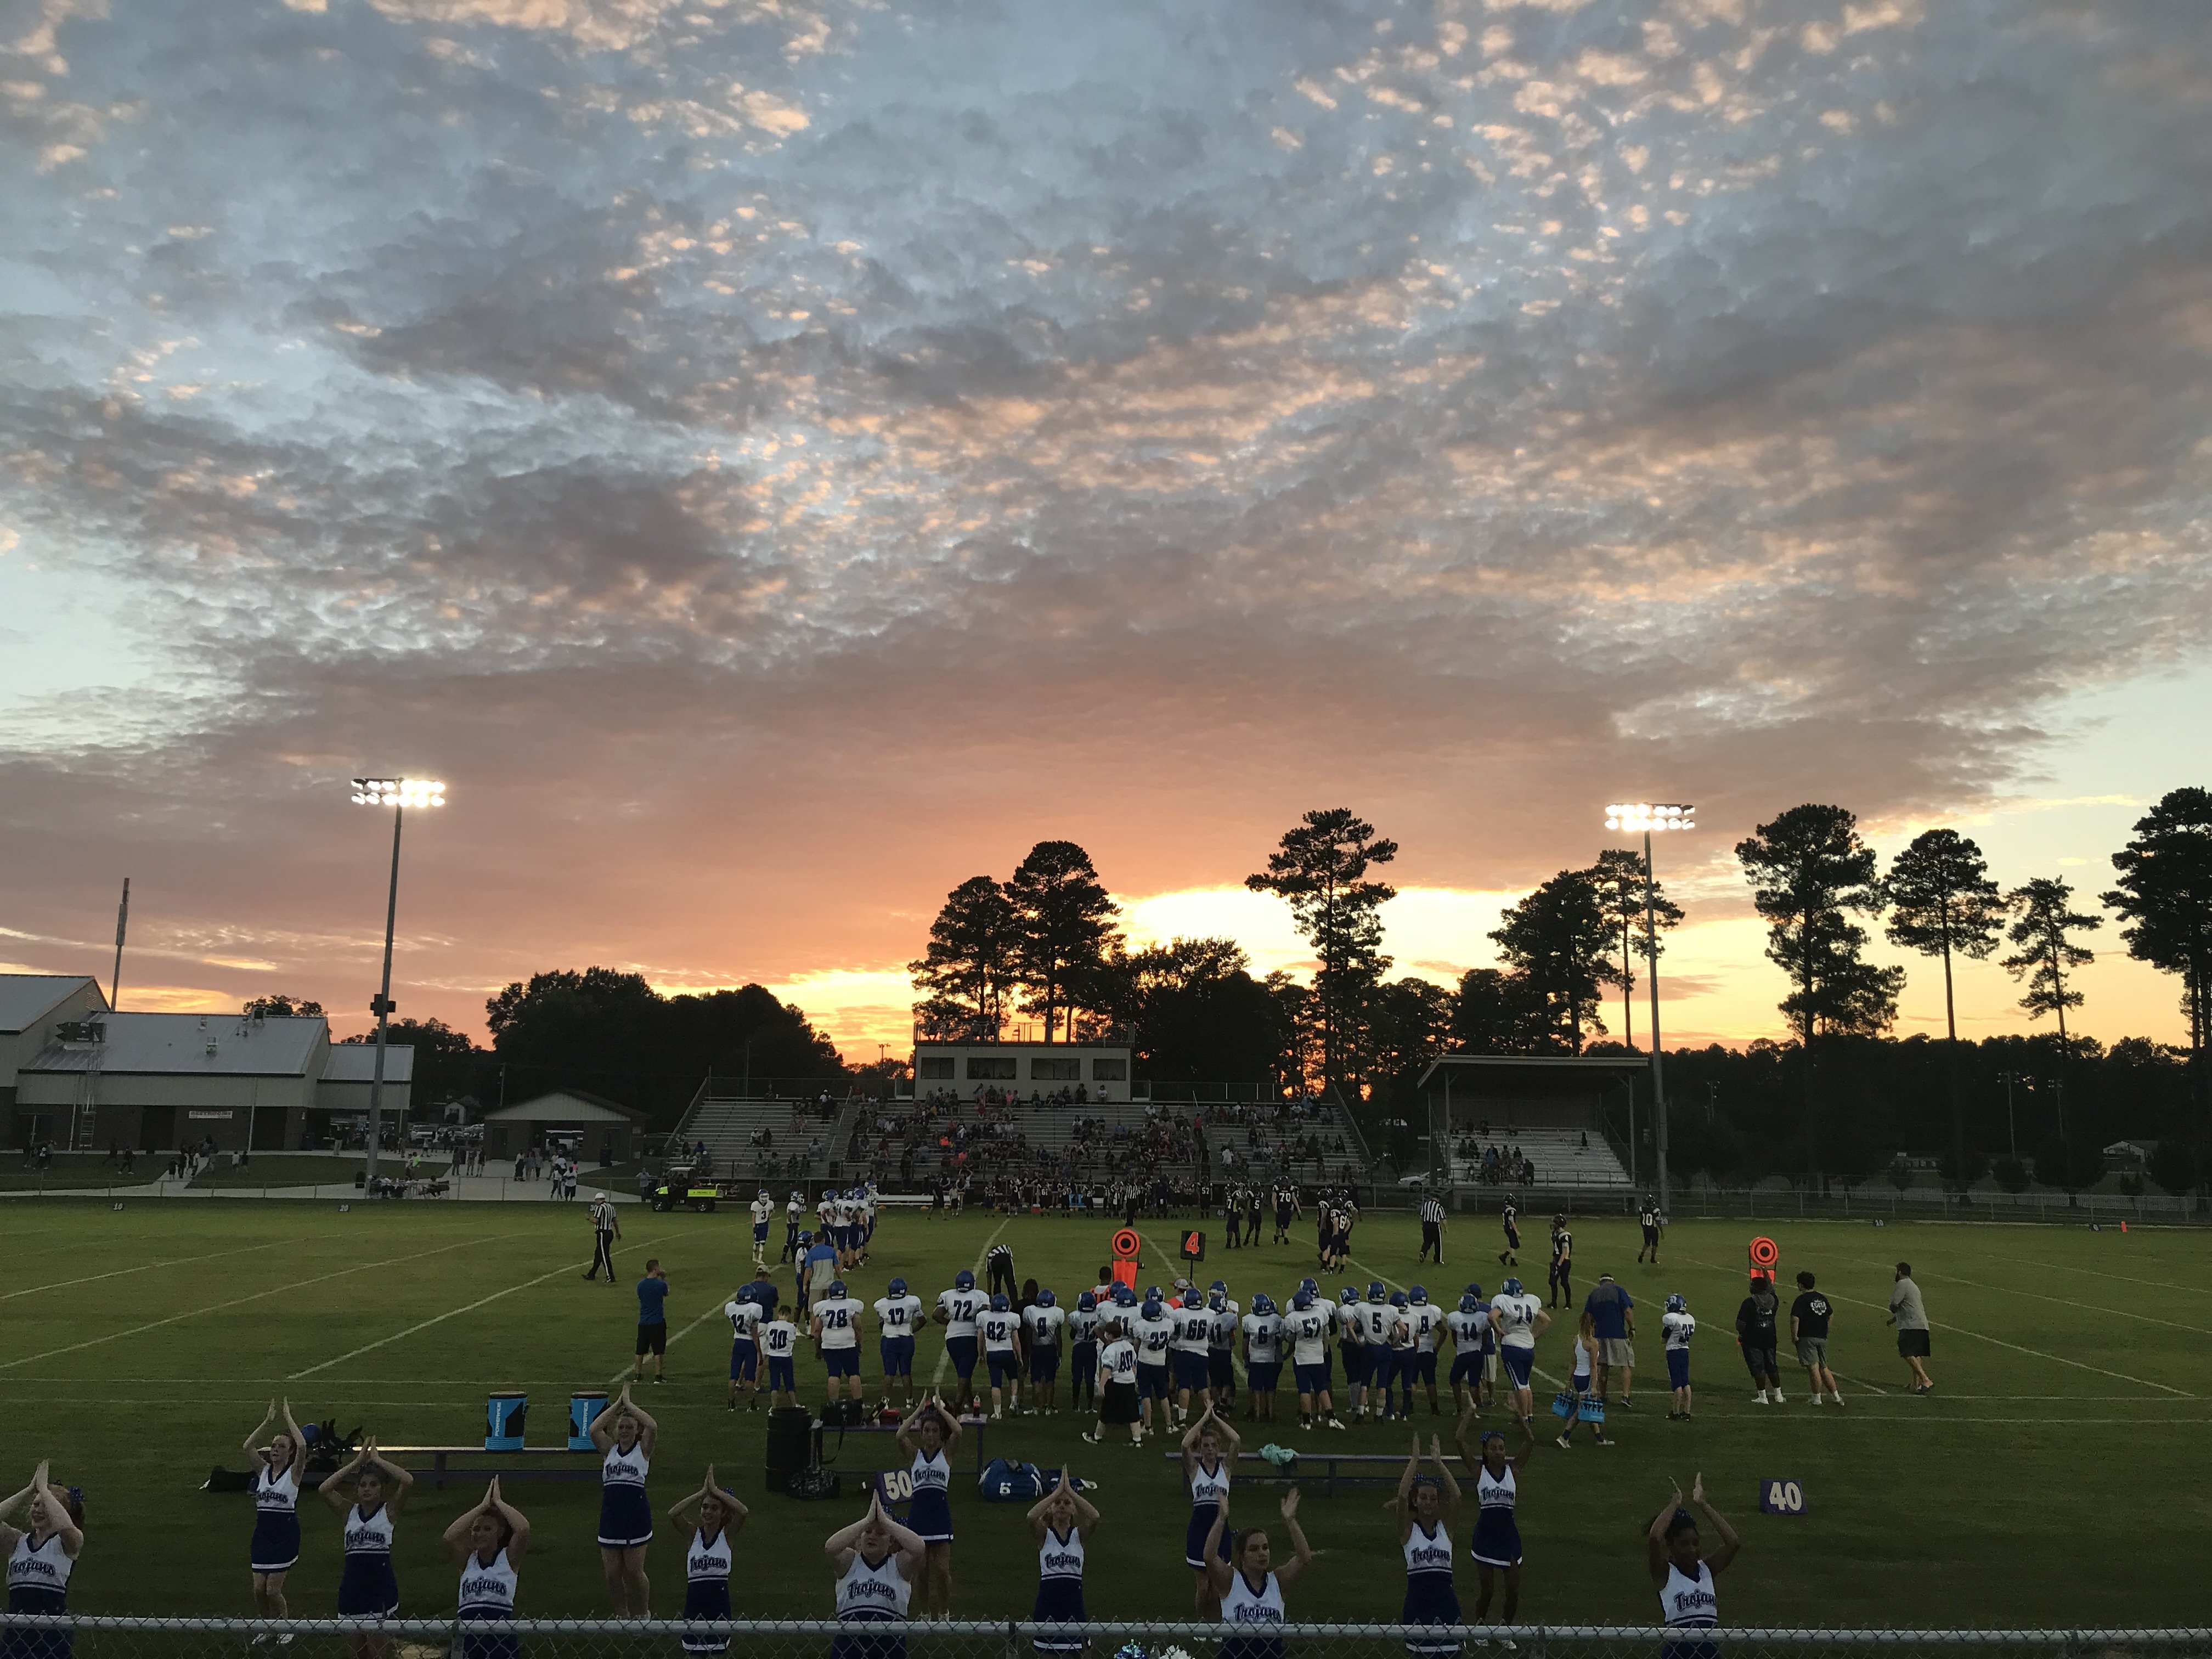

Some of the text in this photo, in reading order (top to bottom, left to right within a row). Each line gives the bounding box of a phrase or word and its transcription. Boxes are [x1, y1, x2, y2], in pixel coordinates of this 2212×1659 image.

[1254, 1199, 1260, 1210] 5
[1279, 1193, 1291, 1202] 70
[761, 1210, 767, 1220] 3
[1642, 1213, 1652, 1226] 10
[1185, 1232, 1200, 1255] 4
[825, 1308, 848, 1329] 78
[888, 1307, 905, 1325] 17
[953, 1300, 973, 1321] 72
[731, 1314, 747, 1334] 12
[986, 1321, 1006, 1342] 82
[1186, 1318, 1207, 1340] 66
[1301, 1316, 1321, 1339] 57
[1372, 1312, 1383, 1333] 5
[1420, 1315, 1429, 1334] 8
[1461, 1322, 1477, 1341] 14
[769, 1328, 788, 1350] 30
[1148, 1330, 1169, 1351] 22
[1258, 1325, 1268, 1344] 6
[605, 1461, 639, 1477] Trojans
[914, 1467, 946, 1483] Trojans
[883, 1470, 913, 1500] 50
[1481, 1486, 1514, 1501] Trojans
[256, 1487, 289, 1504] rojans
[1769, 1481, 1802, 1511] 40
[690, 1554, 728, 1573] Trojans
[1045, 1551, 1081, 1568] Trojans
[1410, 1544, 1451, 1564] Trojans
[847, 1578, 896, 1601] Trojans
[1674, 1588, 1716, 1612] Trojan
[1233, 1601, 1282, 1624] Trojans
